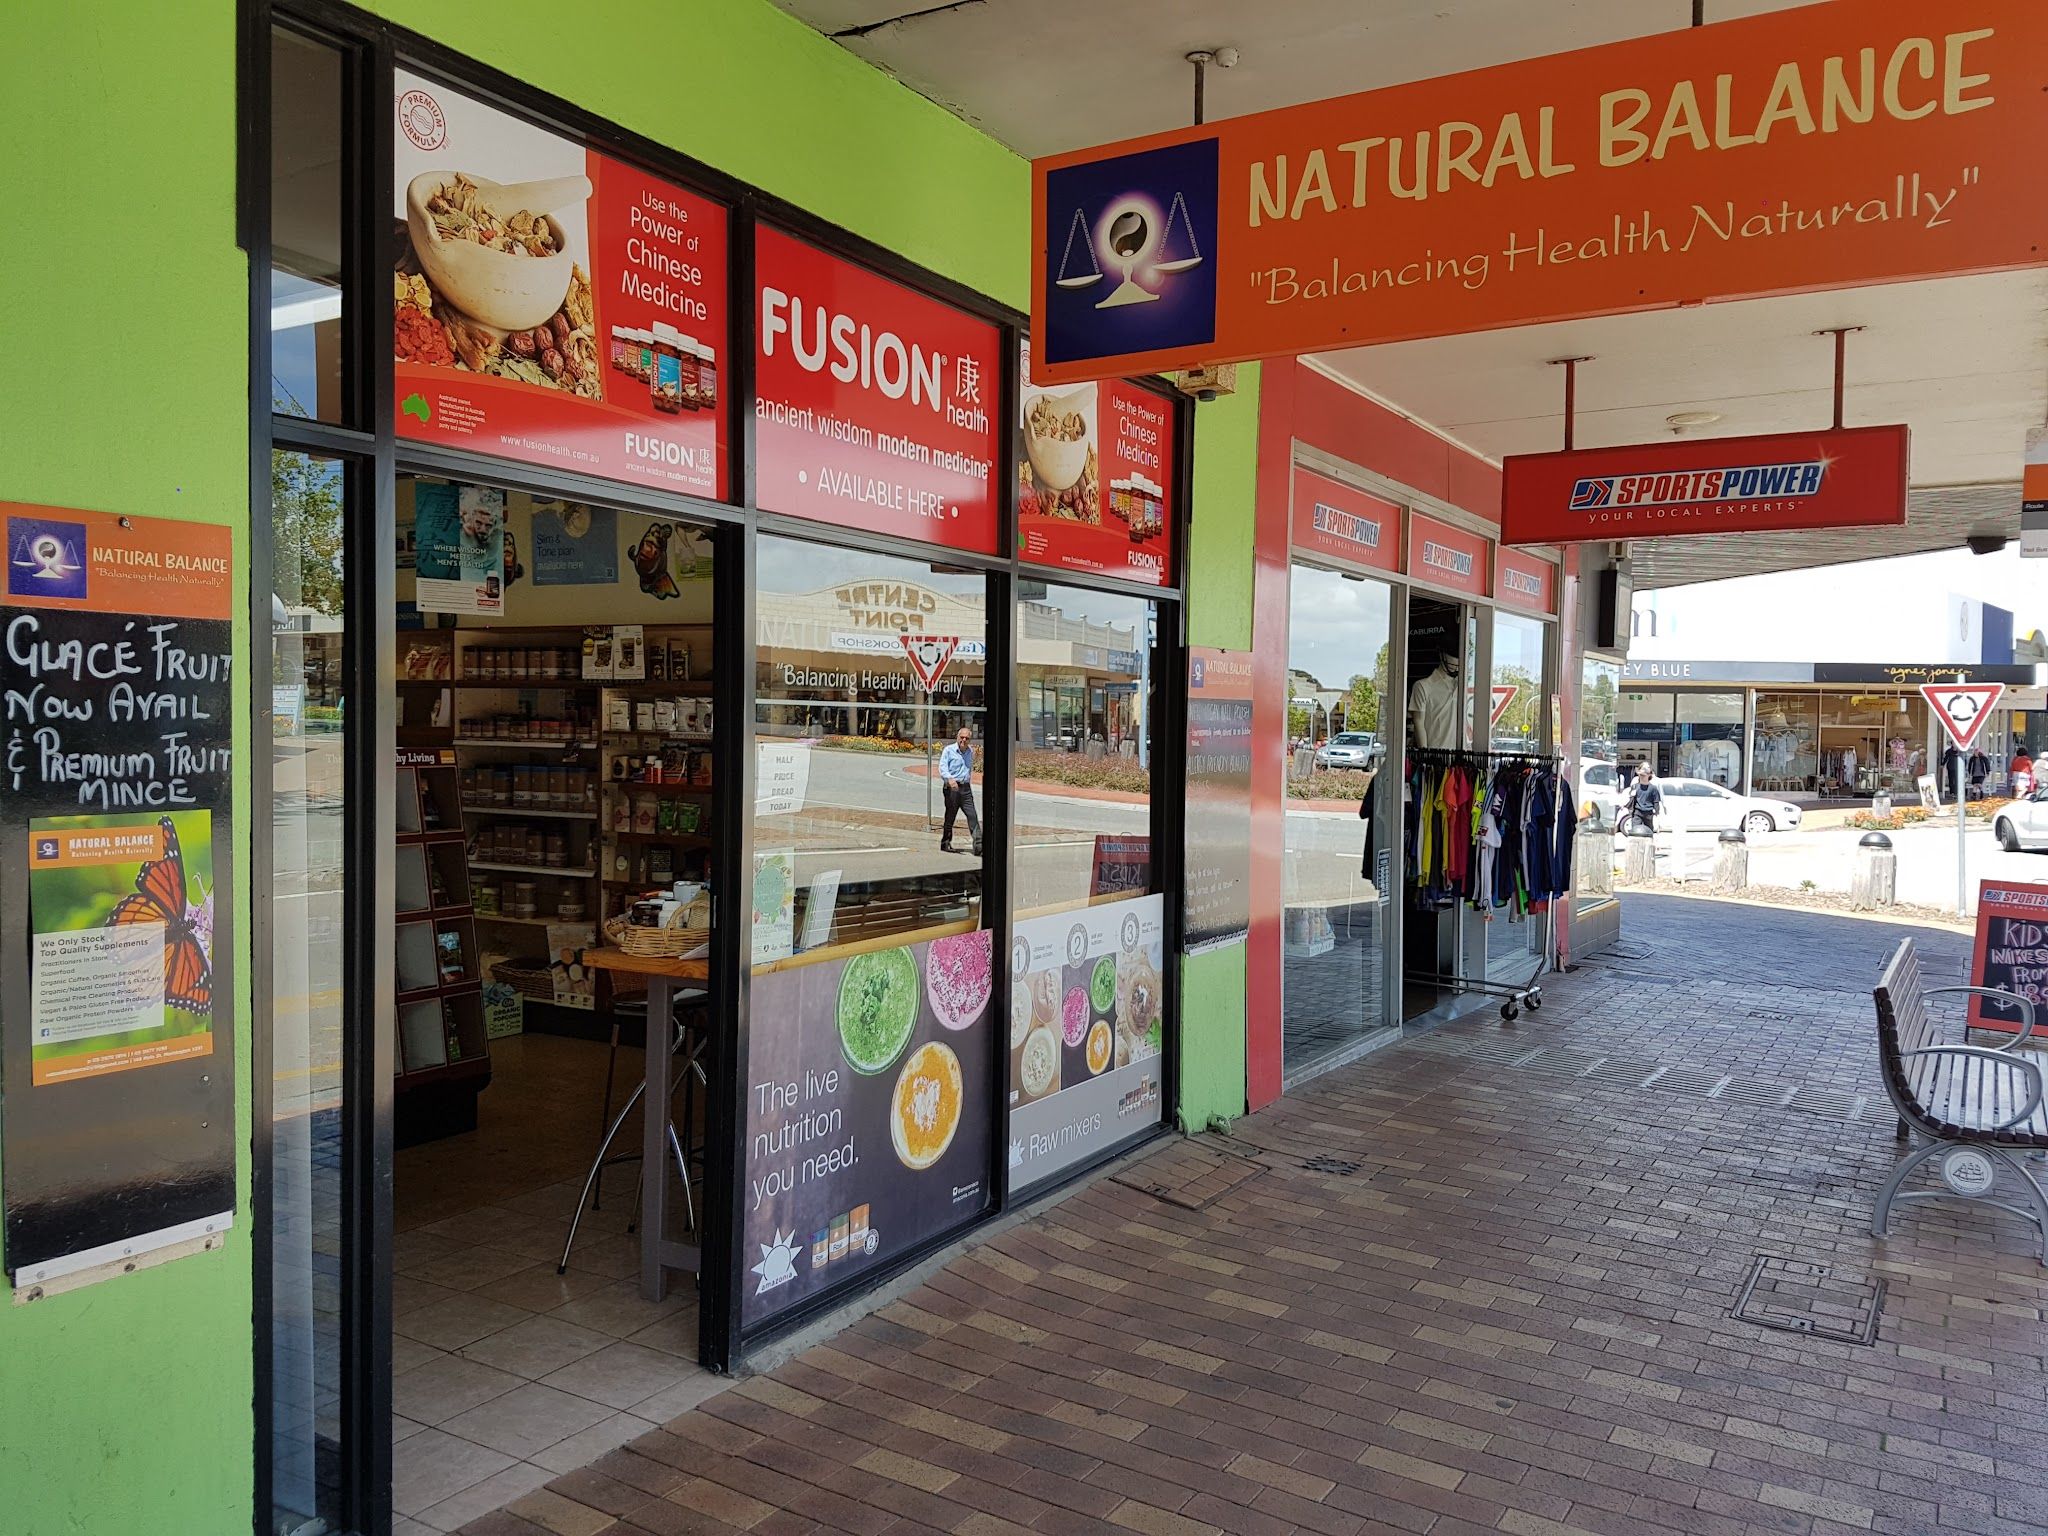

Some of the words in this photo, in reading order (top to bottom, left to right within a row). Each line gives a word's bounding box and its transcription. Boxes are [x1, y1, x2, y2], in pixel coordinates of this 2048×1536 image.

[408, 94, 442, 128] PREMIUM
[402, 113, 438, 146] FORMULA
[1248, 105, 1576, 228] NATURAL
[1598, 27, 1996, 169] BALANCE
[643, 190, 665, 213] Use
[669, 202, 688, 222] the
[631, 206, 684, 246] Power
[687, 237, 699, 252] of
[1249, 247, 1490, 306] "Balancing
[1503, 212, 1670, 274] Health
[1679, 165, 1980, 255] Naturally"
[627, 238, 702, 286] Chinese
[622, 270, 707, 321] Medicine
[947, 396, 989, 435] health
[1112, 395, 1125, 412] Use
[1126, 400, 1137, 416] the
[1138, 405, 1157, 423] Power
[1157, 413, 1164, 426] of
[756, 397, 814, 433] ancient
[817, 414, 873, 449] wisdom
[878, 432, 929, 464] modern
[1119, 416, 1157, 446] Chinese
[500, 435, 600, 464] www.fusionhealth.com.au
[1116, 437, 1159, 468] Medicine
[695, 463, 715, 475] health
[817, 467, 903, 511] AVAILABLE
[907, 487, 945, 519] HERE
[1617, 464, 1821, 505] SPORTSPOWER
[1327, 510, 1379, 545] SPORTSPOWER
[1646, 507, 1702, 519] LOCAL
[434, 544, 457, 552] WHERE
[458, 546, 487, 555] WISDOM
[536, 534, 554, 545] Slim
[555, 535, 561, 544] &
[536, 546, 556, 557] Tone
[1334, 538, 1350, 551] LOCAL
[1352, 544, 1373, 557] EXPERTS
[92, 547, 162, 568] NATURAL
[166, 554, 228, 574] BALANCE
[437, 559, 458, 567] MEN'S
[1128, 550, 1157, 569] FUSION
[1433, 544, 1471, 573] SPORTSPOWER
[96, 567, 147, 583] "Balancing
[149, 573, 178, 584] Health
[179, 574, 225, 587] Naturally"
[7, 614, 142, 682] GLACÉ
[147, 622, 232, 682] FRUIT
[861, 670, 905, 692] Health
[1651, 663, 1691, 677] BLUE
[1890, 666, 1927, 684] agnes
[4, 683, 93, 725] NOW
[109, 682, 211, 722] AVAIL
[33, 727, 155, 782] PREMIUM
[160, 732, 232, 776] FRUIT
[408, 753, 435, 764] Living
[78, 778, 197, 810] MINCE
[770, 802, 792, 811] TODAY
[69, 837, 111, 849] NATURAL
[115, 835, 154, 846] BALANCE
[40, 940, 55, 948] We
[58, 938, 78, 946] Only
[81, 935, 105, 943] Stock
[40, 949, 57, 957] Top
[59, 945, 91, 954] Quality
[94, 939, 149, 951] Supplements
[1074, 935, 1082, 956] 2
[1126, 924, 1134, 943] 3
[1015, 949, 1022, 970] 1
[40, 978, 67, 986] Organic
[92, 973, 117, 981] Organic
[56, 1014, 81, 1022] Organic
[107, 1007, 134, 1015] Powders
[754, 1080, 798, 1115] The
[805, 1069, 839, 1101] live
[754, 1108, 842, 1160] nutrition
[1029, 1130, 1060, 1161] Raw
[1060, 1112, 1101, 1147] mixers
[753, 1165, 794, 1211] you
[802, 1135, 859, 1184] need.
[761, 1271, 793, 1291] amazonia
